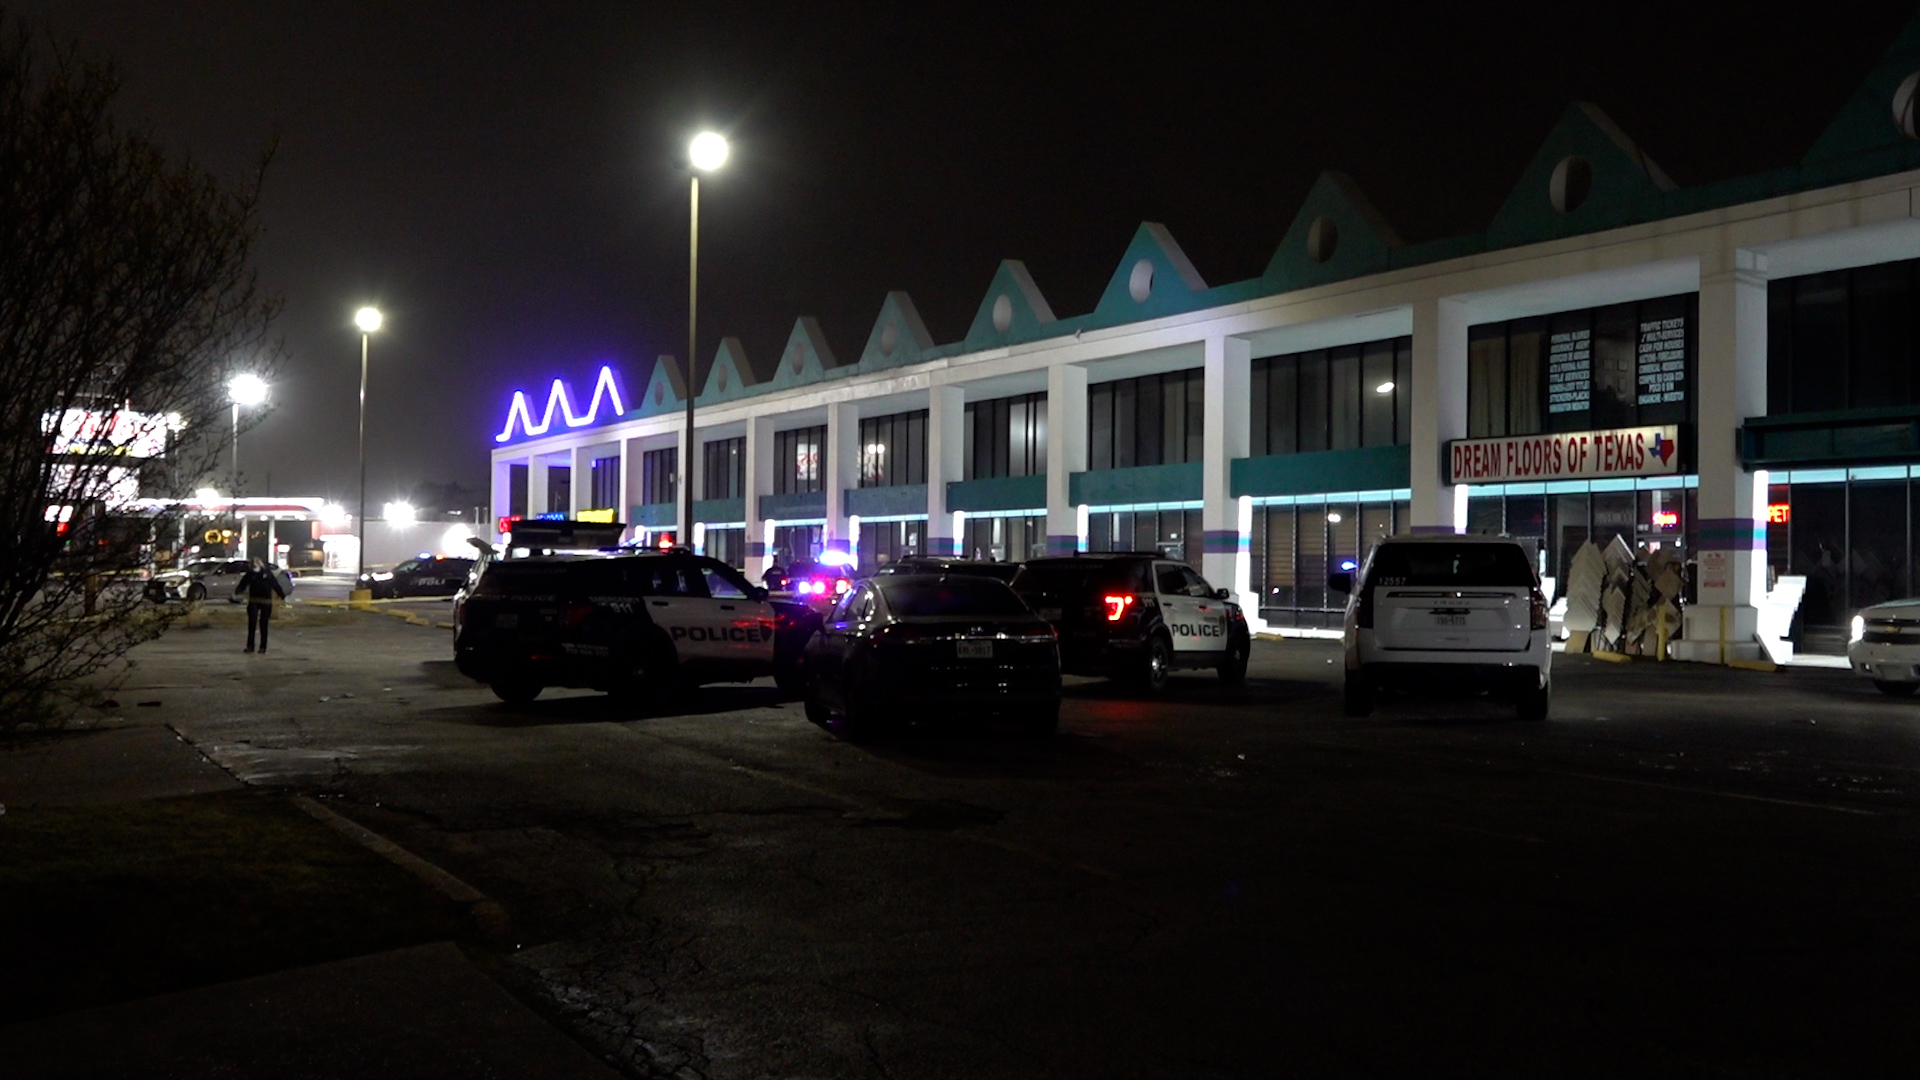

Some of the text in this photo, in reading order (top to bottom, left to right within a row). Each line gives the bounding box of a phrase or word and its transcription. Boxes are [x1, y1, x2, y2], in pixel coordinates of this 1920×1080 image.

[1662, 318, 1684, 330] TICKETS
[1454, 433, 1645, 478] DREAM FLOORS OF TEXAS
[1379, 577, 1406, 585] 12557
[610, 602, 634, 614] 911
[669, 626, 761, 643] POLICE
[1171, 623, 1220, 637] POLICE
